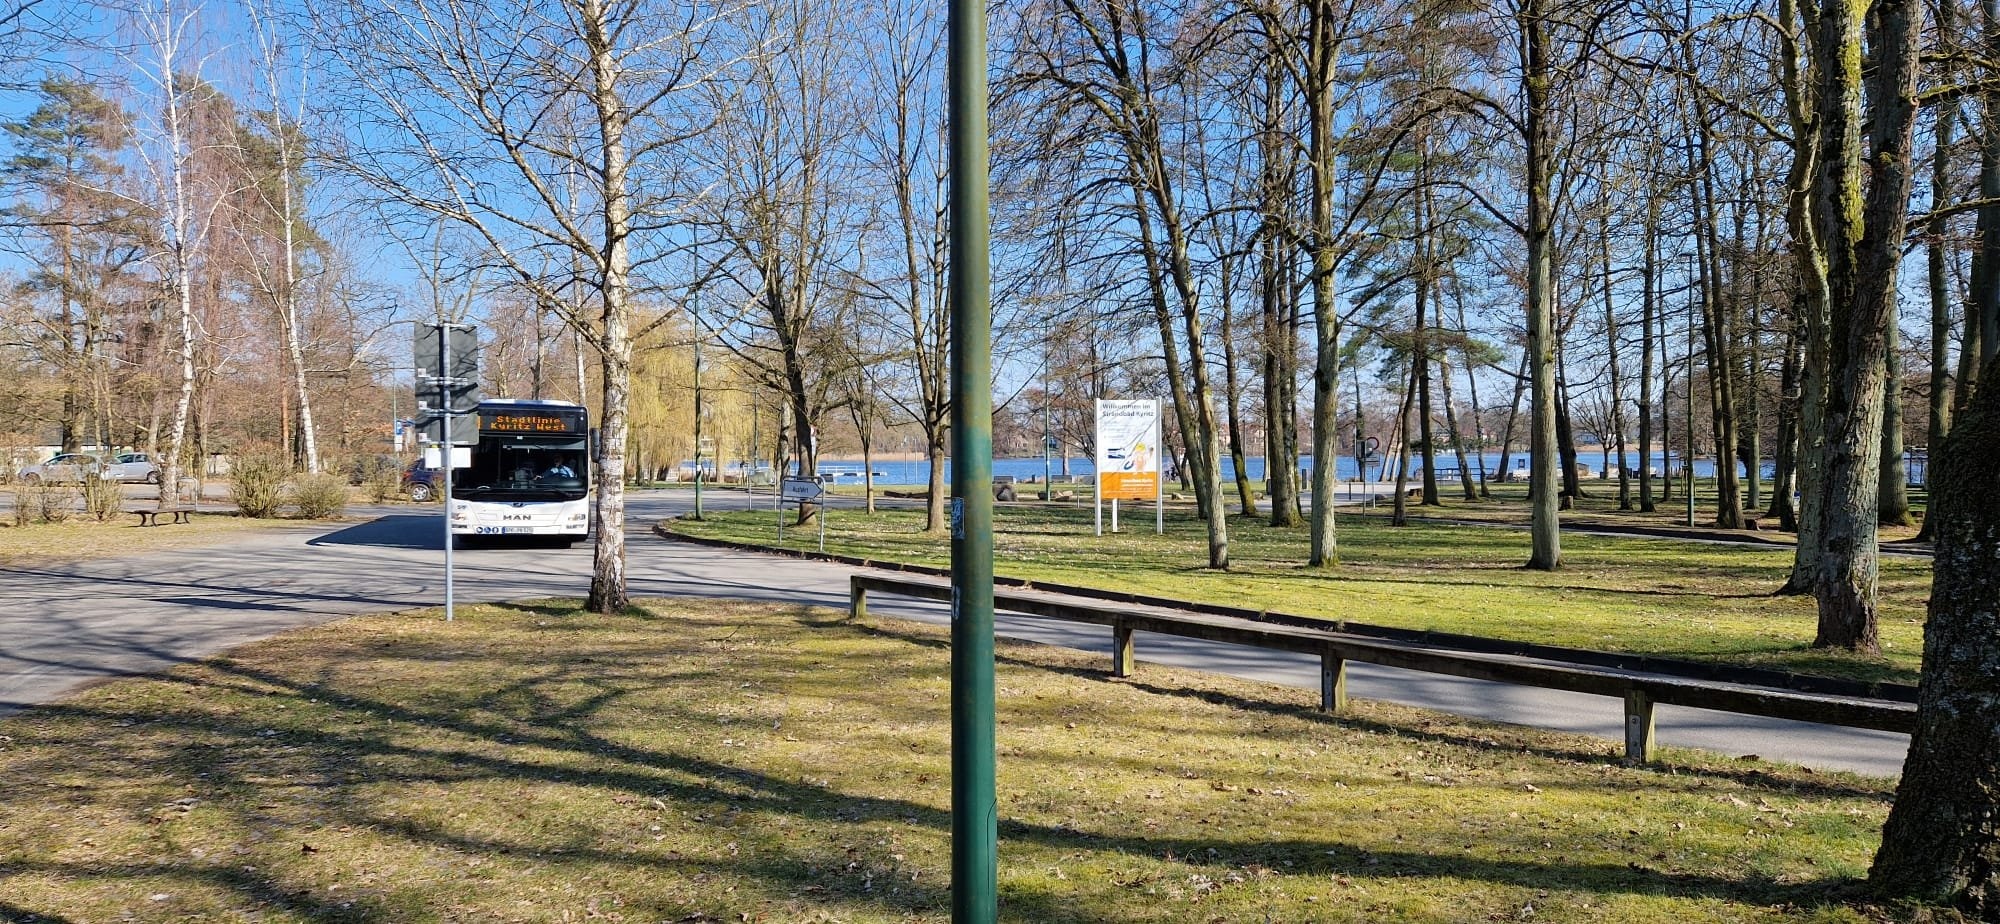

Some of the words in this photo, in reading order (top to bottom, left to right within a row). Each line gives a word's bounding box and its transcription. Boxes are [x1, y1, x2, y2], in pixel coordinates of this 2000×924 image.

[496, 415, 561, 424] Stadtlinie
[490, 422, 532, 431] Kyritz
[536, 423, 567, 431] West
